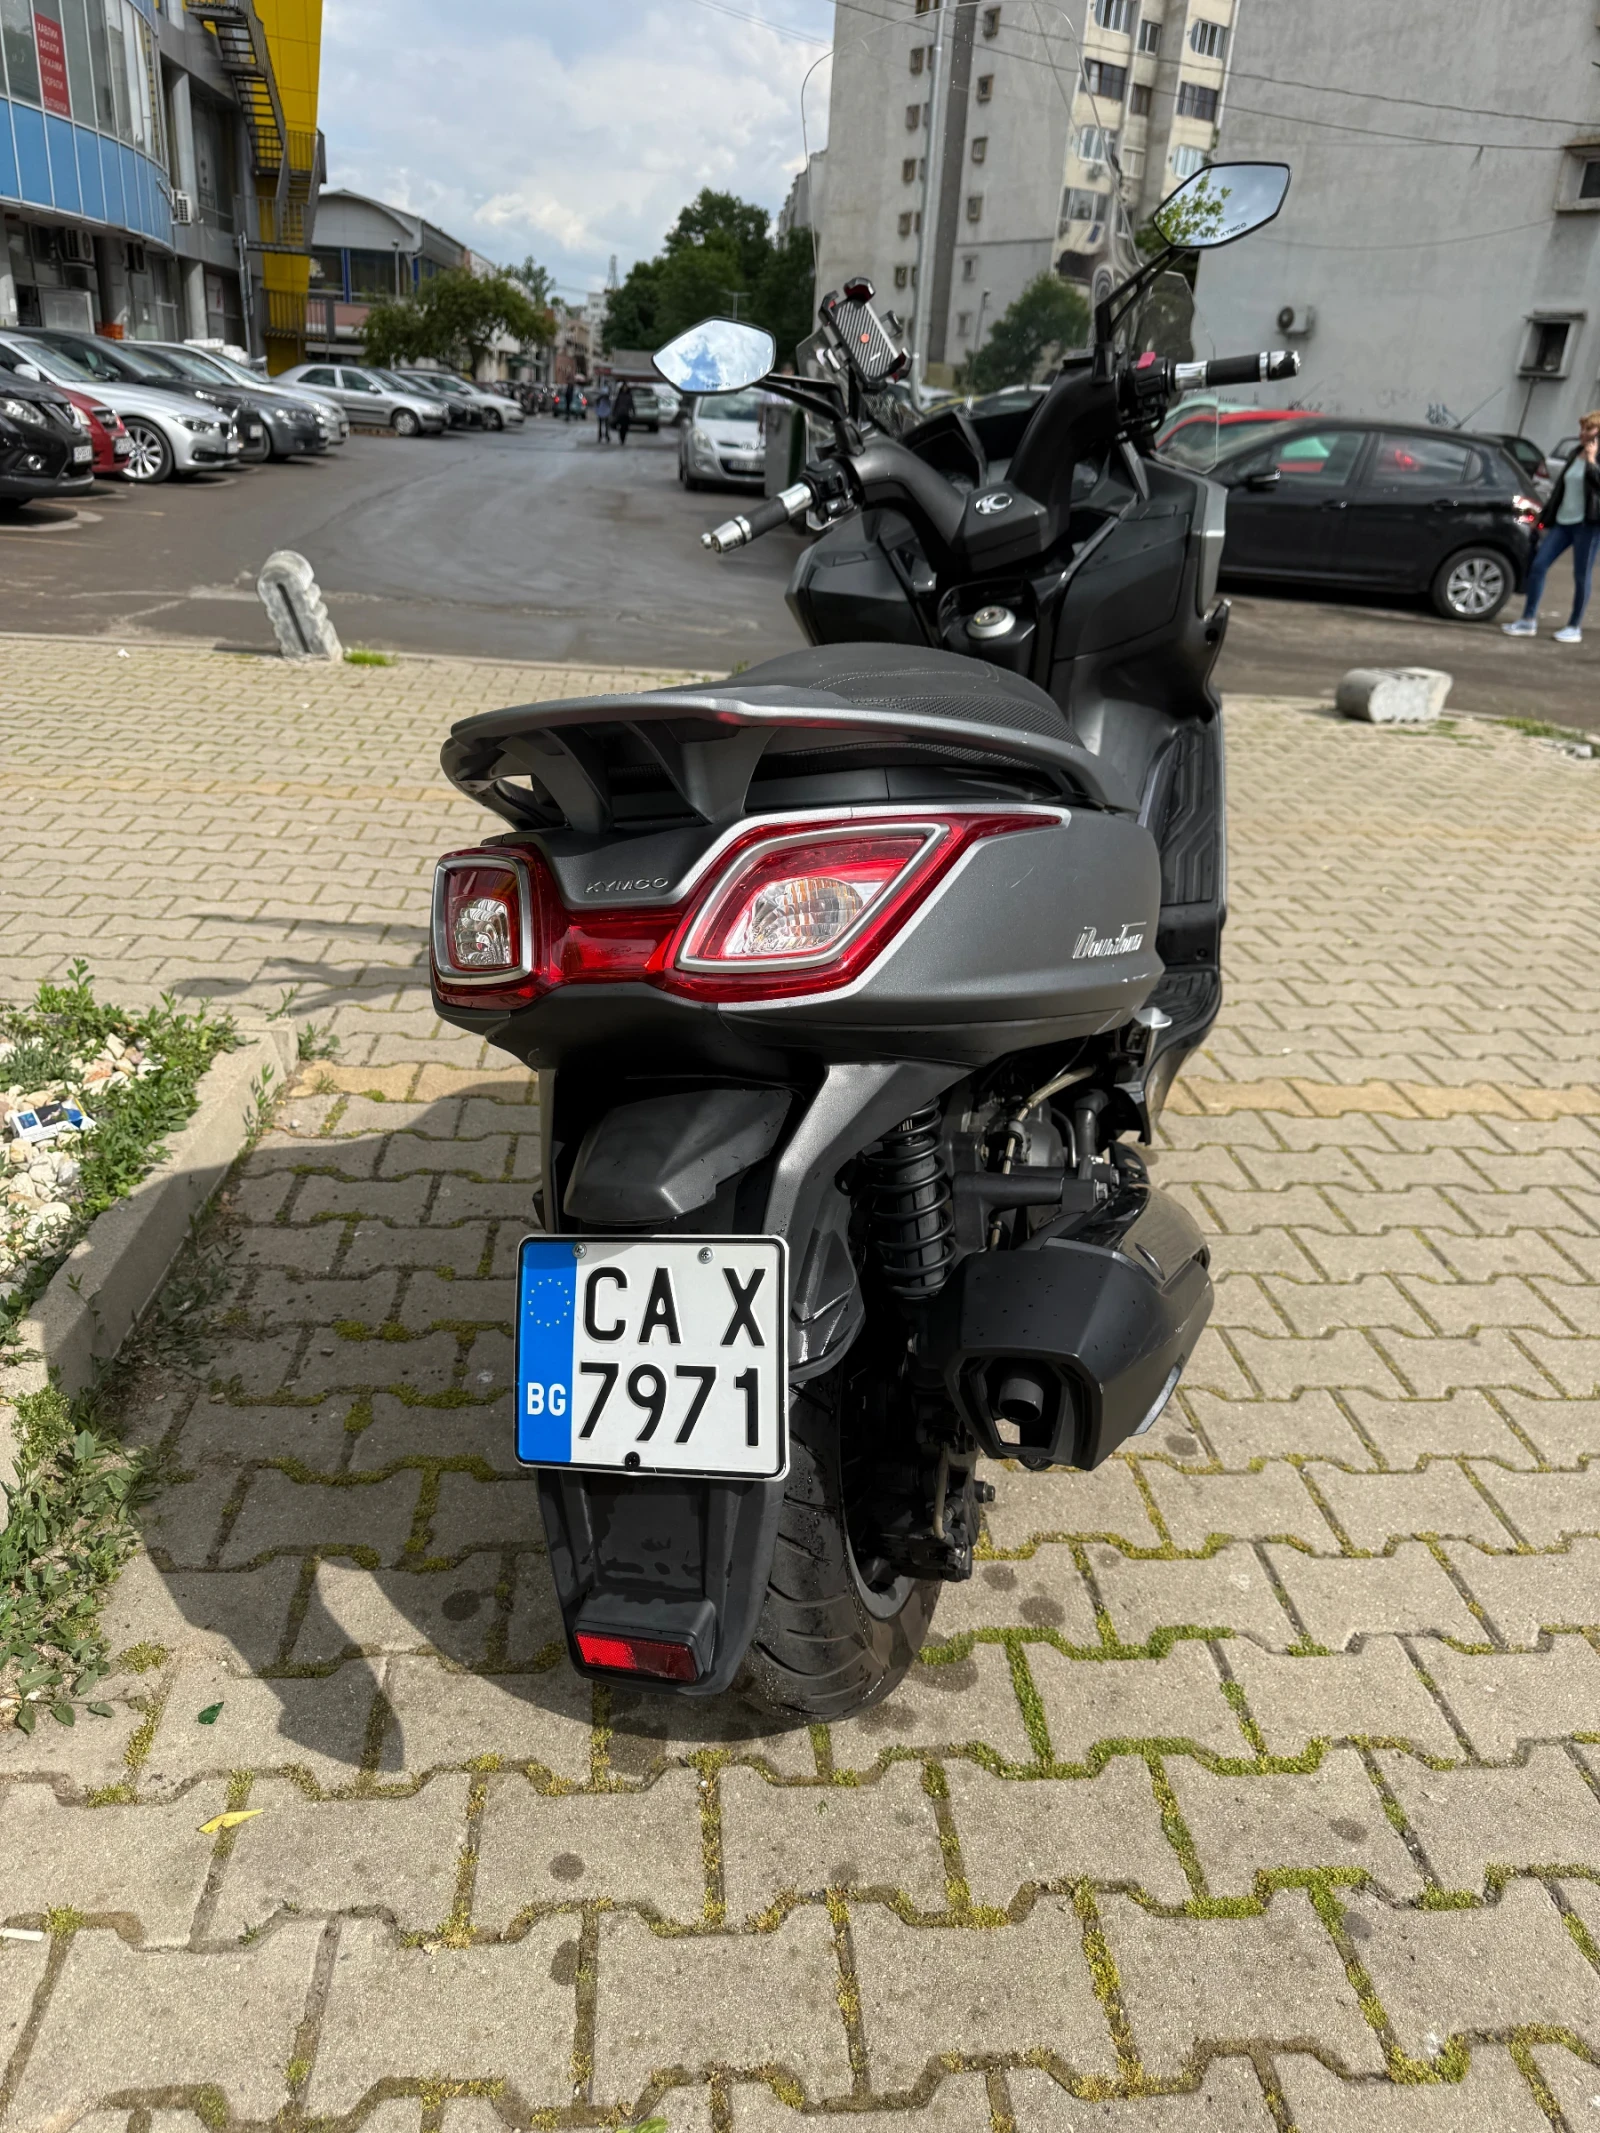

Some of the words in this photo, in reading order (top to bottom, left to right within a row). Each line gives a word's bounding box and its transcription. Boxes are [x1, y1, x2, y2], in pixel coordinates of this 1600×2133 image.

[1220, 222, 1247, 237] KYMCO
[584, 877, 669, 893] KYMCO
[720, 1267, 767, 1346] X
[527, 1382, 566, 1416] BG
[579, 1361, 760, 1447] 7971
